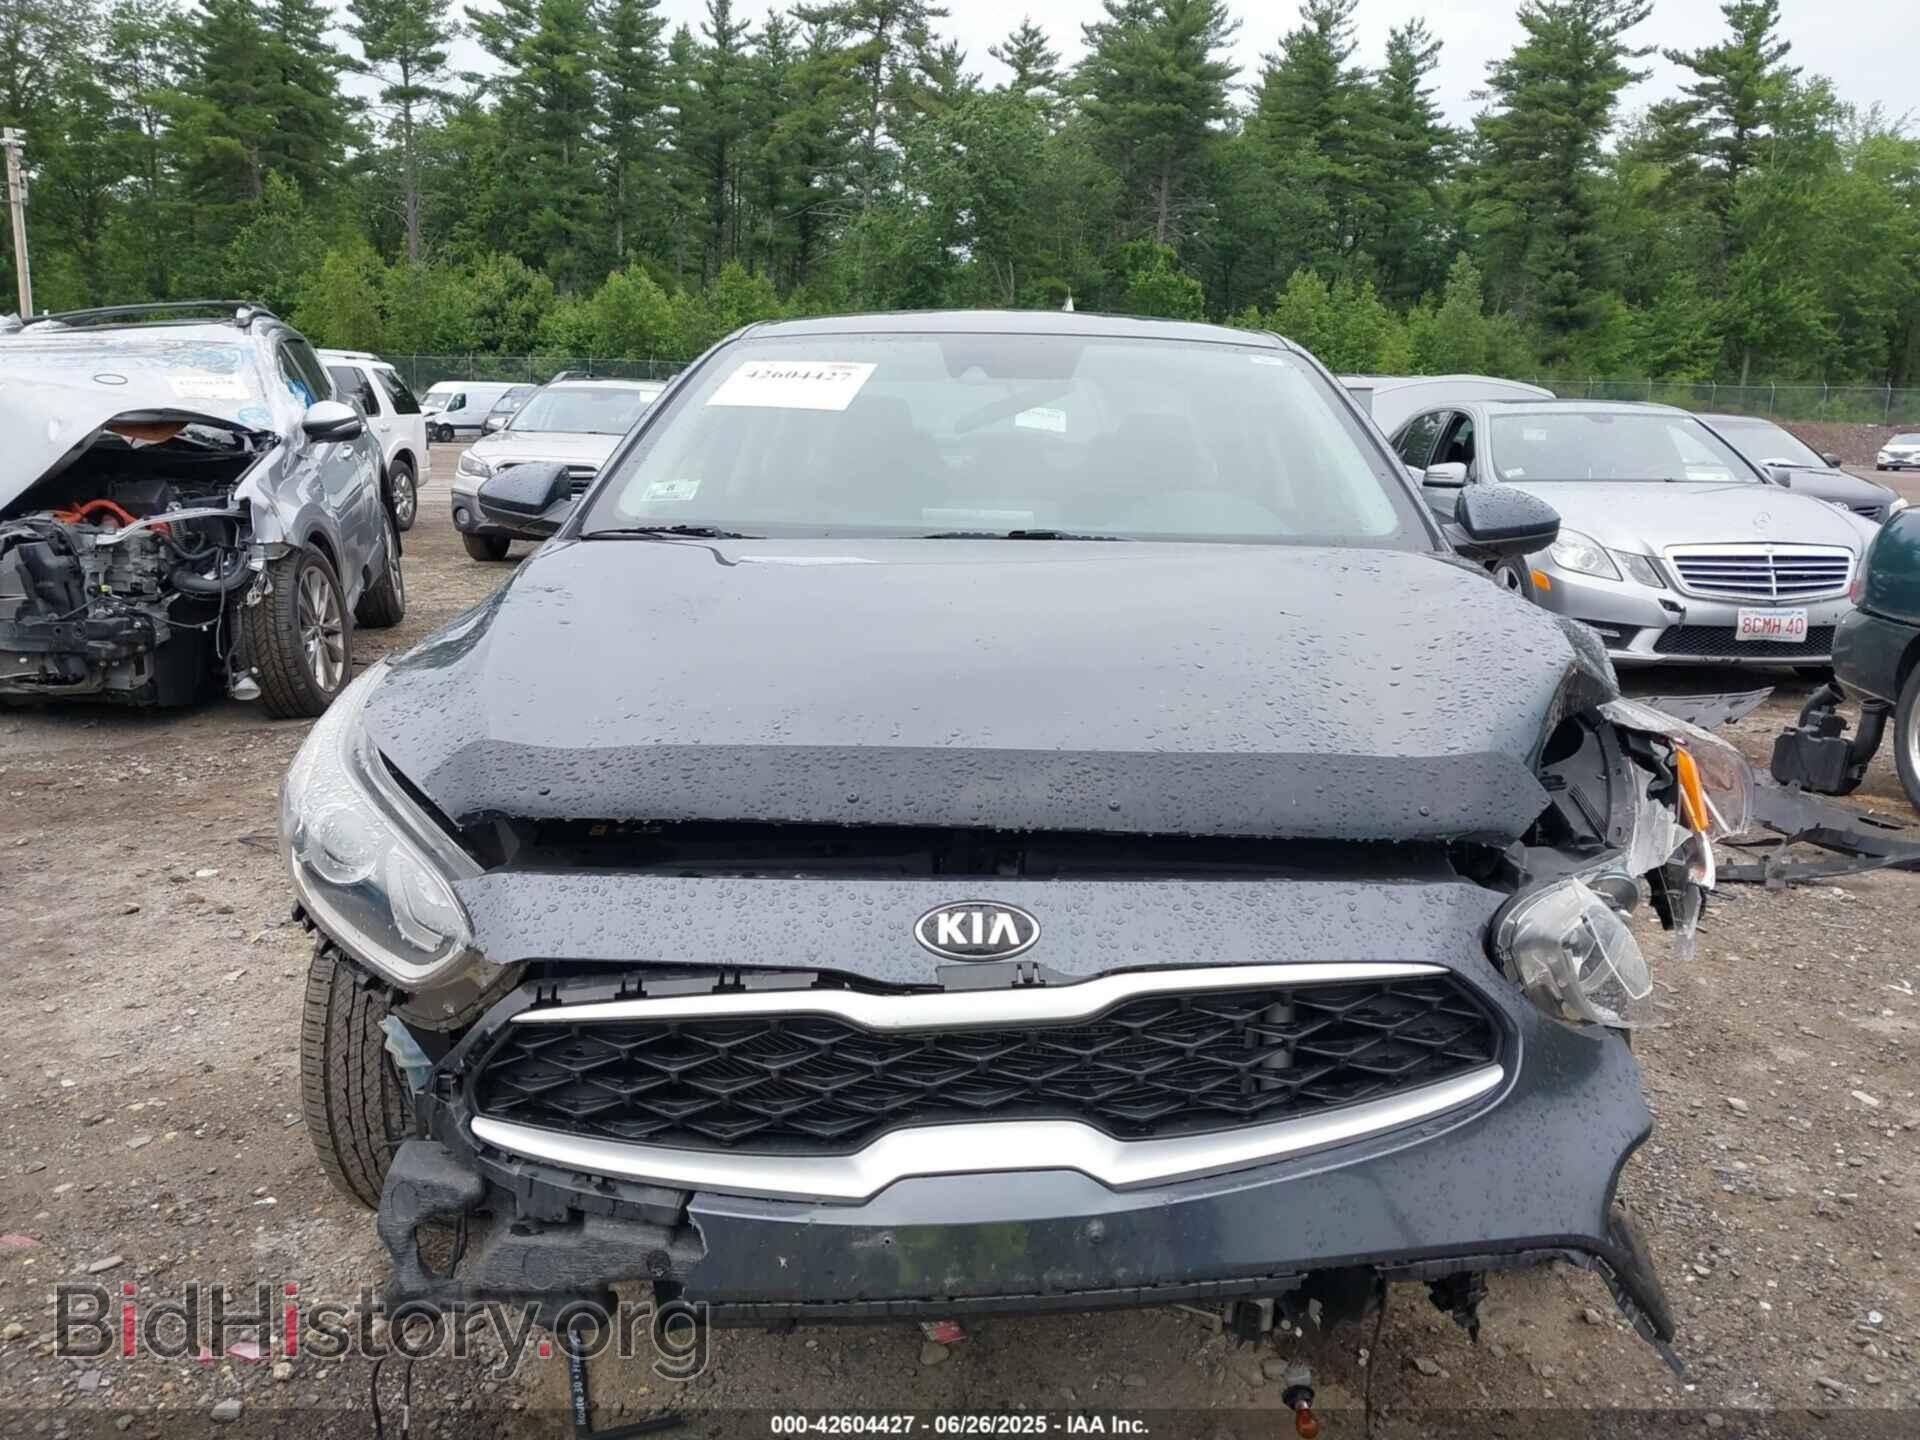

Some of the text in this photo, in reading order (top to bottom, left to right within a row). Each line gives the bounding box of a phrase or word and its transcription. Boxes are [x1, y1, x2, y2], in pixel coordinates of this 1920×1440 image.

[745, 369, 853, 381] 42604427
[1742, 617, 1804, 634] 8CMH 40
[937, 912, 1020, 945] KIA
